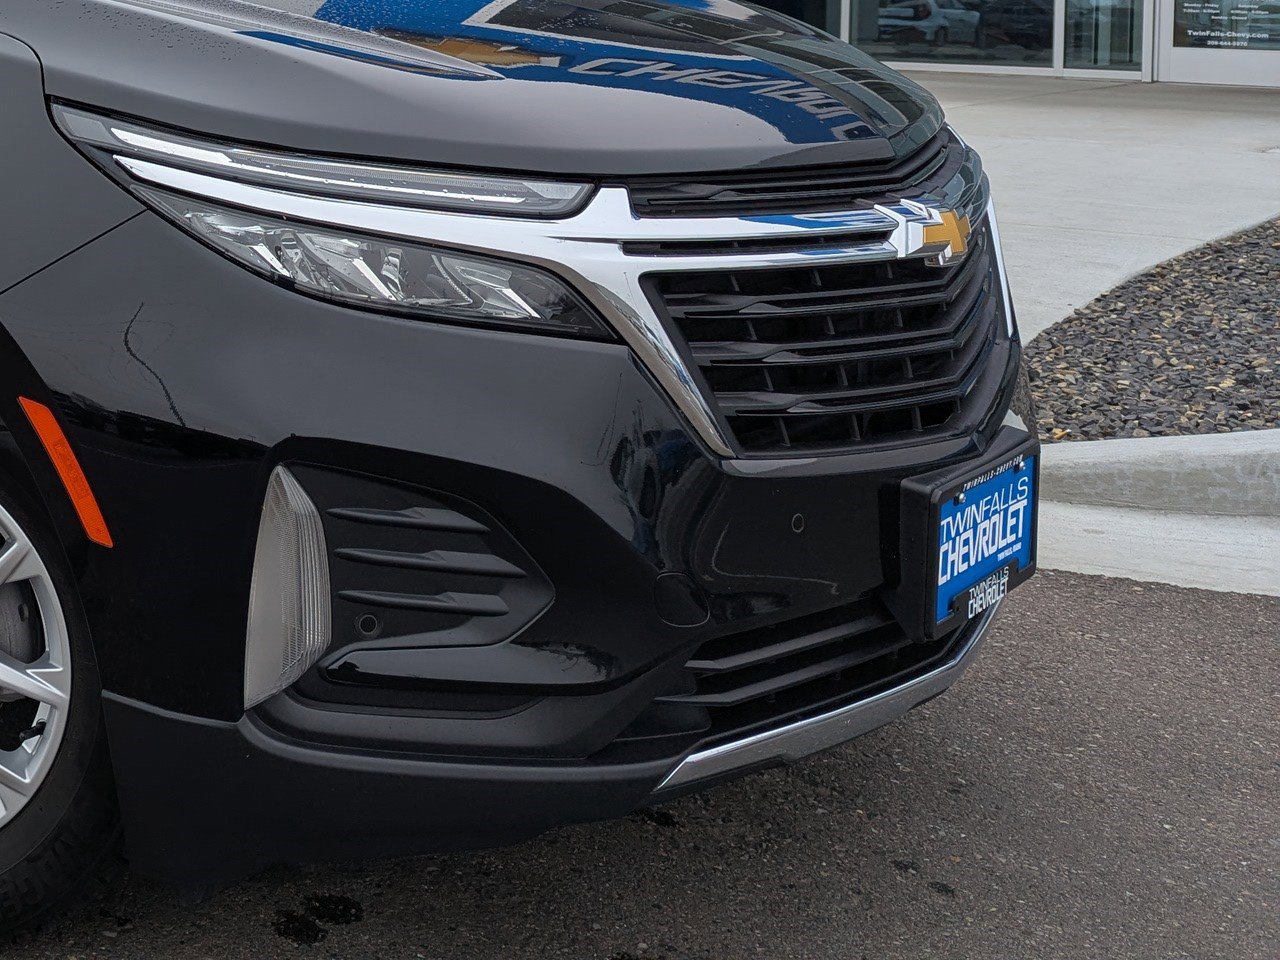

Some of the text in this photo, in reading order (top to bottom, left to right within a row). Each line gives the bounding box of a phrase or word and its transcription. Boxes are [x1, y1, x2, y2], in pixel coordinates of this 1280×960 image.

[1187, 30, 1269, 39] TwinFalls-Chevy.com
[940, 476, 1029, 544] TWINFALLS
[938, 498, 1028, 586] CHEVROLET
[968, 577, 1009, 619] CHEVROLET
[969, 566, 1010, 600] TWINFALLS
